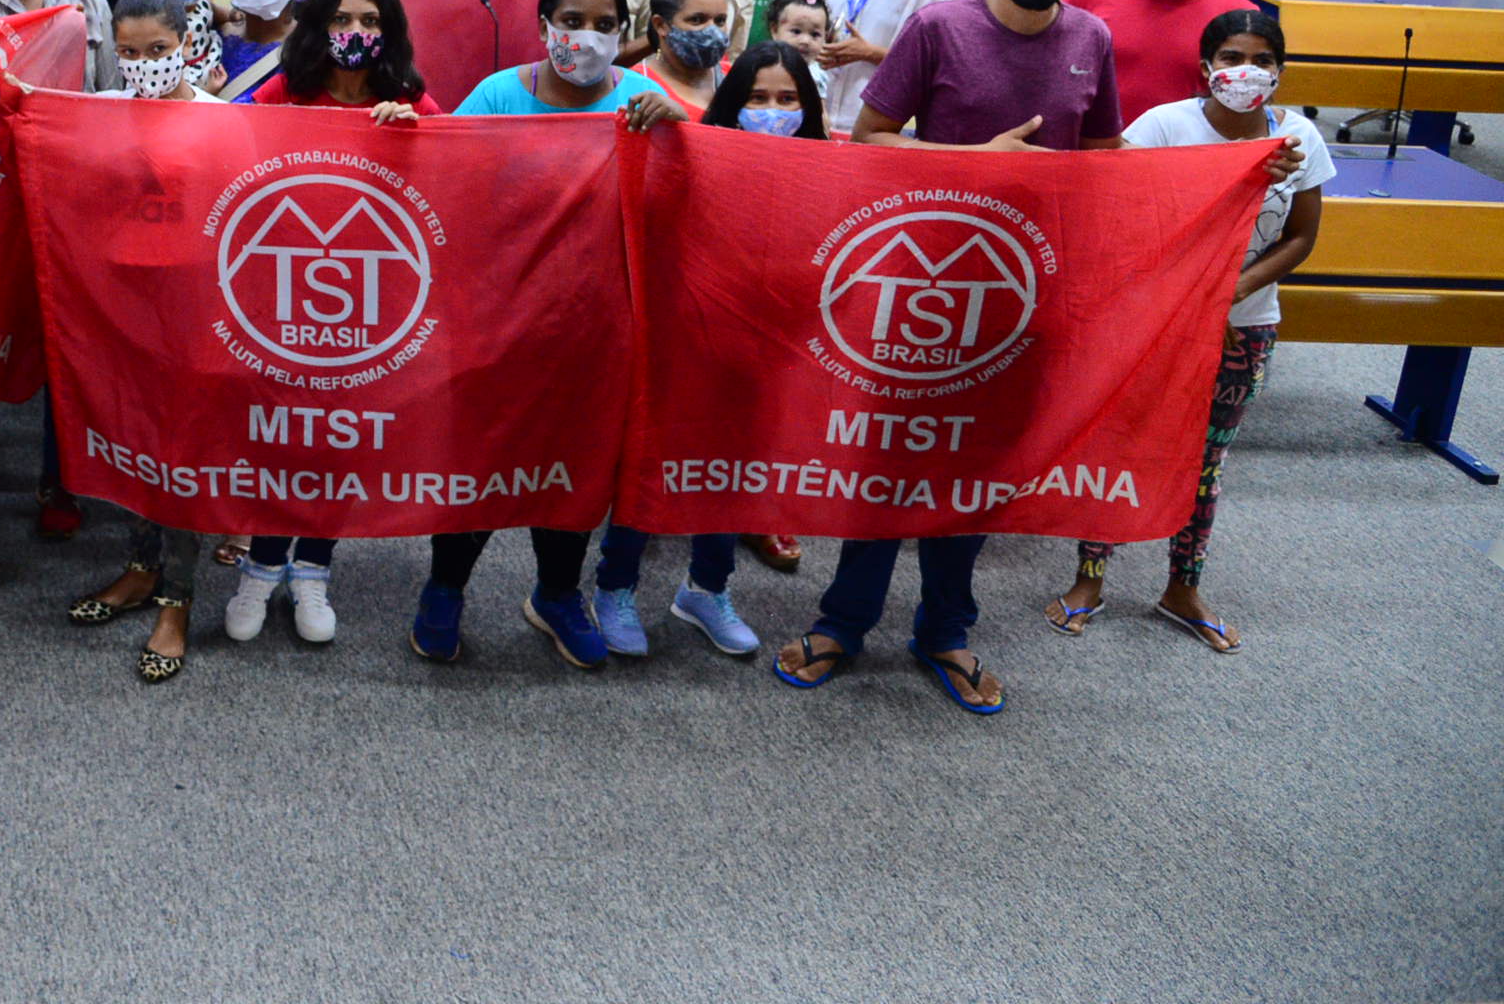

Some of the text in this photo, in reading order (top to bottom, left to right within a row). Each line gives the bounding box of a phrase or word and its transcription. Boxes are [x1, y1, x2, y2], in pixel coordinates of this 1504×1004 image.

[203, 171, 256, 238] MOVIMENTO
[254, 157, 284, 176] DOS
[284, 150, 404, 189] TRABALHADORES
[403, 185, 426, 213] SEM
[423, 209, 446, 246] TETO
[811, 189, 1057, 276] MOVIMENTO DOS TRABALHADORES SEM TETO
[212, 316, 439, 390] NA LUTA PELA REFORMA URBANA
[281, 324, 377, 349] BRASIL
[872, 342, 968, 366] BRASIL
[806, 335, 1035, 400] NA LUTA PELA REFORMA URBANA
[248, 403, 395, 451] MTST
[825, 408, 975, 452] MTST
[86, 427, 573, 506] RESISTÊNCIA URBANA
[662, 458, 937, 510] RESISTÊNCIA
